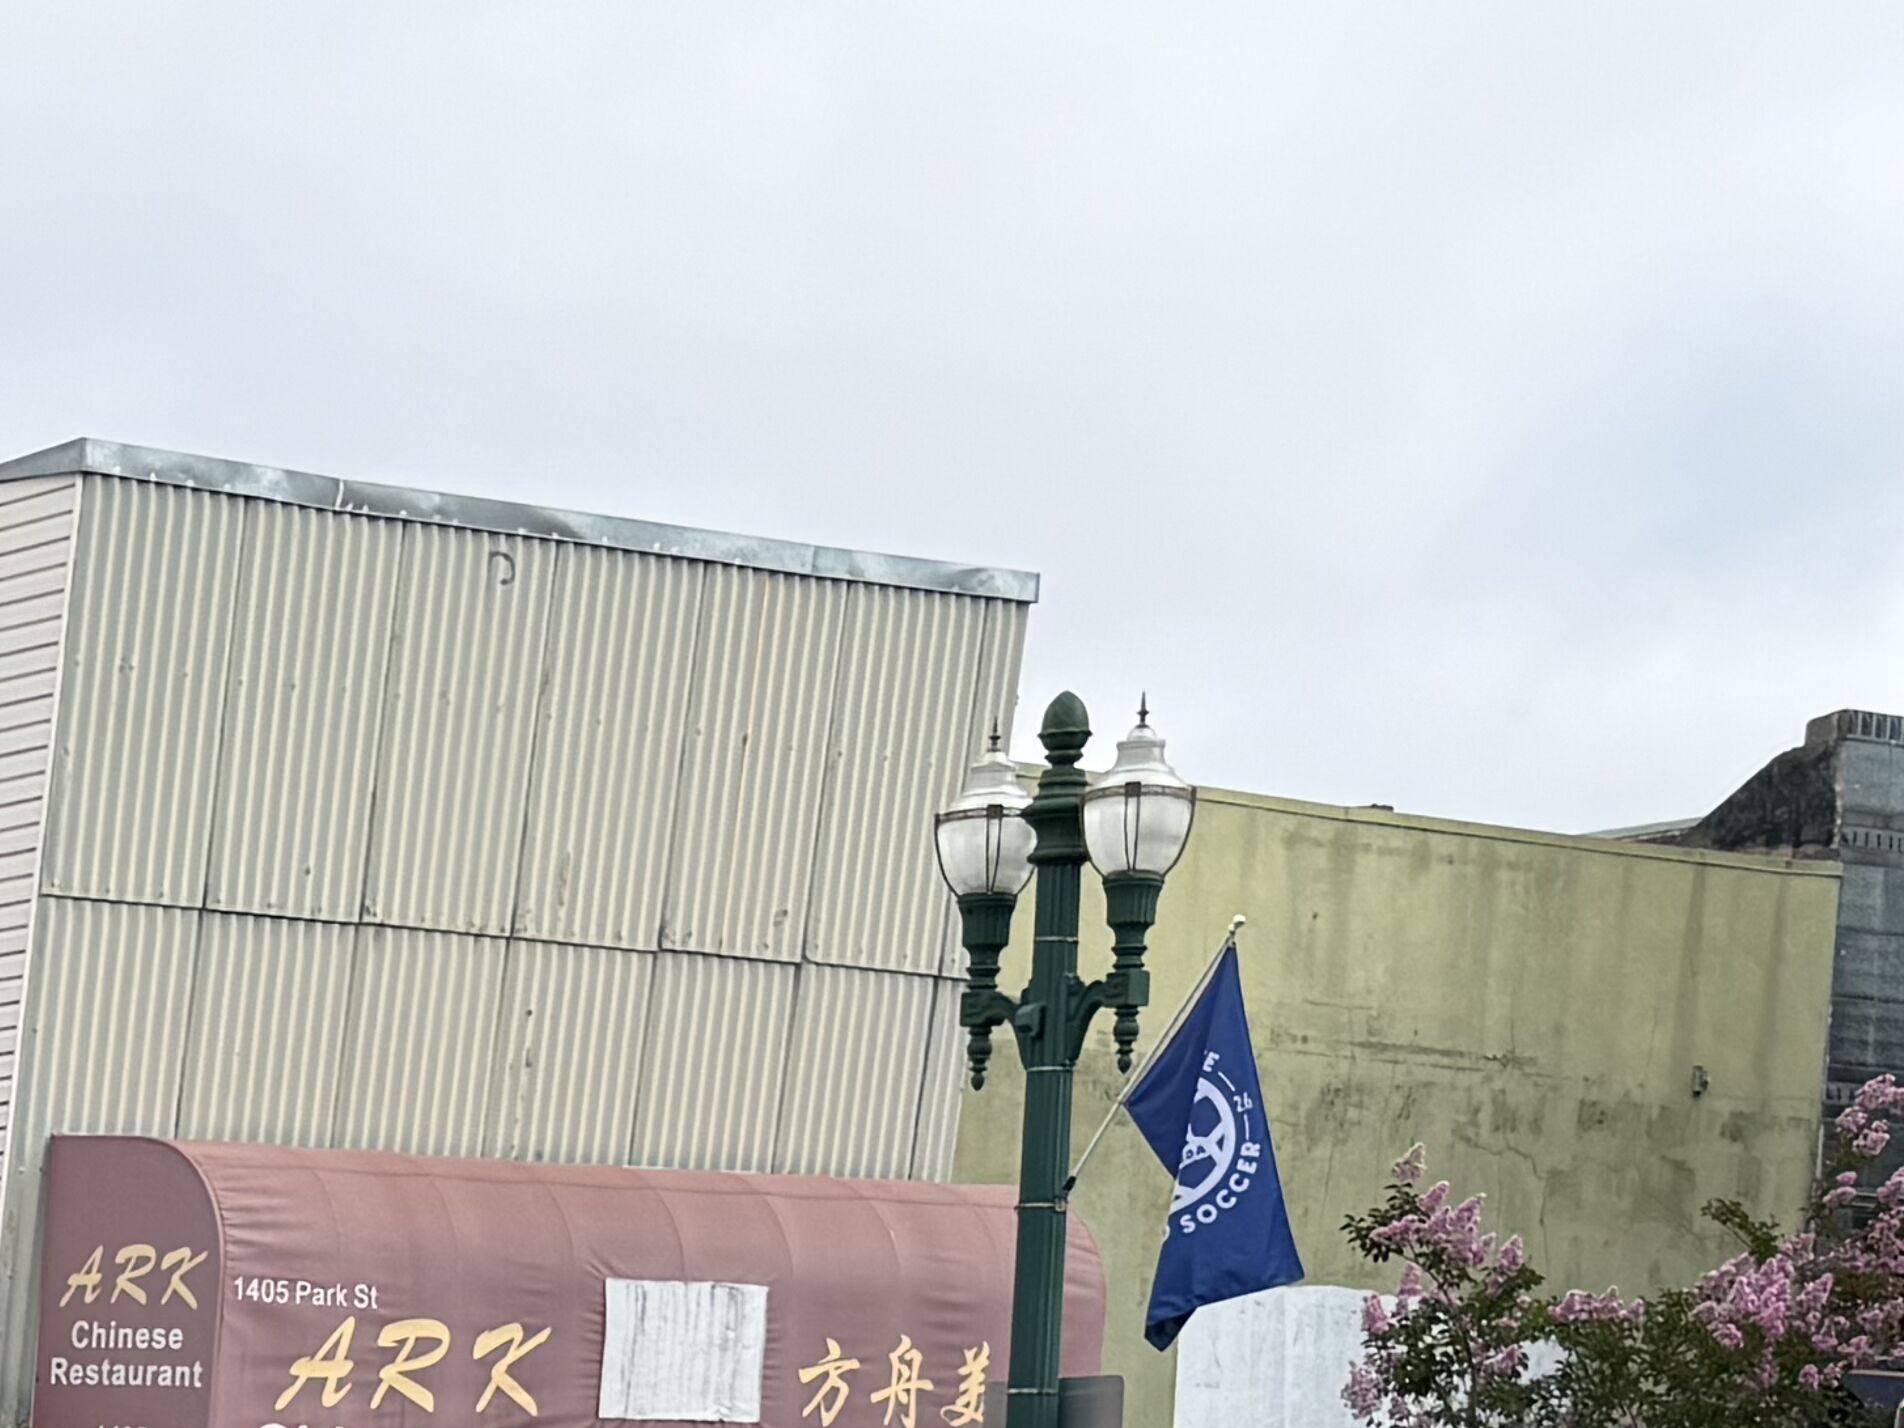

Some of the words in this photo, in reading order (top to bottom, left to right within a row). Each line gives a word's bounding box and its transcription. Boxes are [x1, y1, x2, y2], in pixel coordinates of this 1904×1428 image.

[1180, 1141, 1261, 1234] SOCCER
[59, 1244, 208, 1311] ARK
[233, 1277, 289, 1303] 1405
[295, 1282, 347, 1307] Park
[353, 1284, 379, 1309] St
[71, 1320, 183, 1350] Chinese
[49, 1358, 203, 1389] Restaurant
[274, 1316, 552, 1417] ARK
